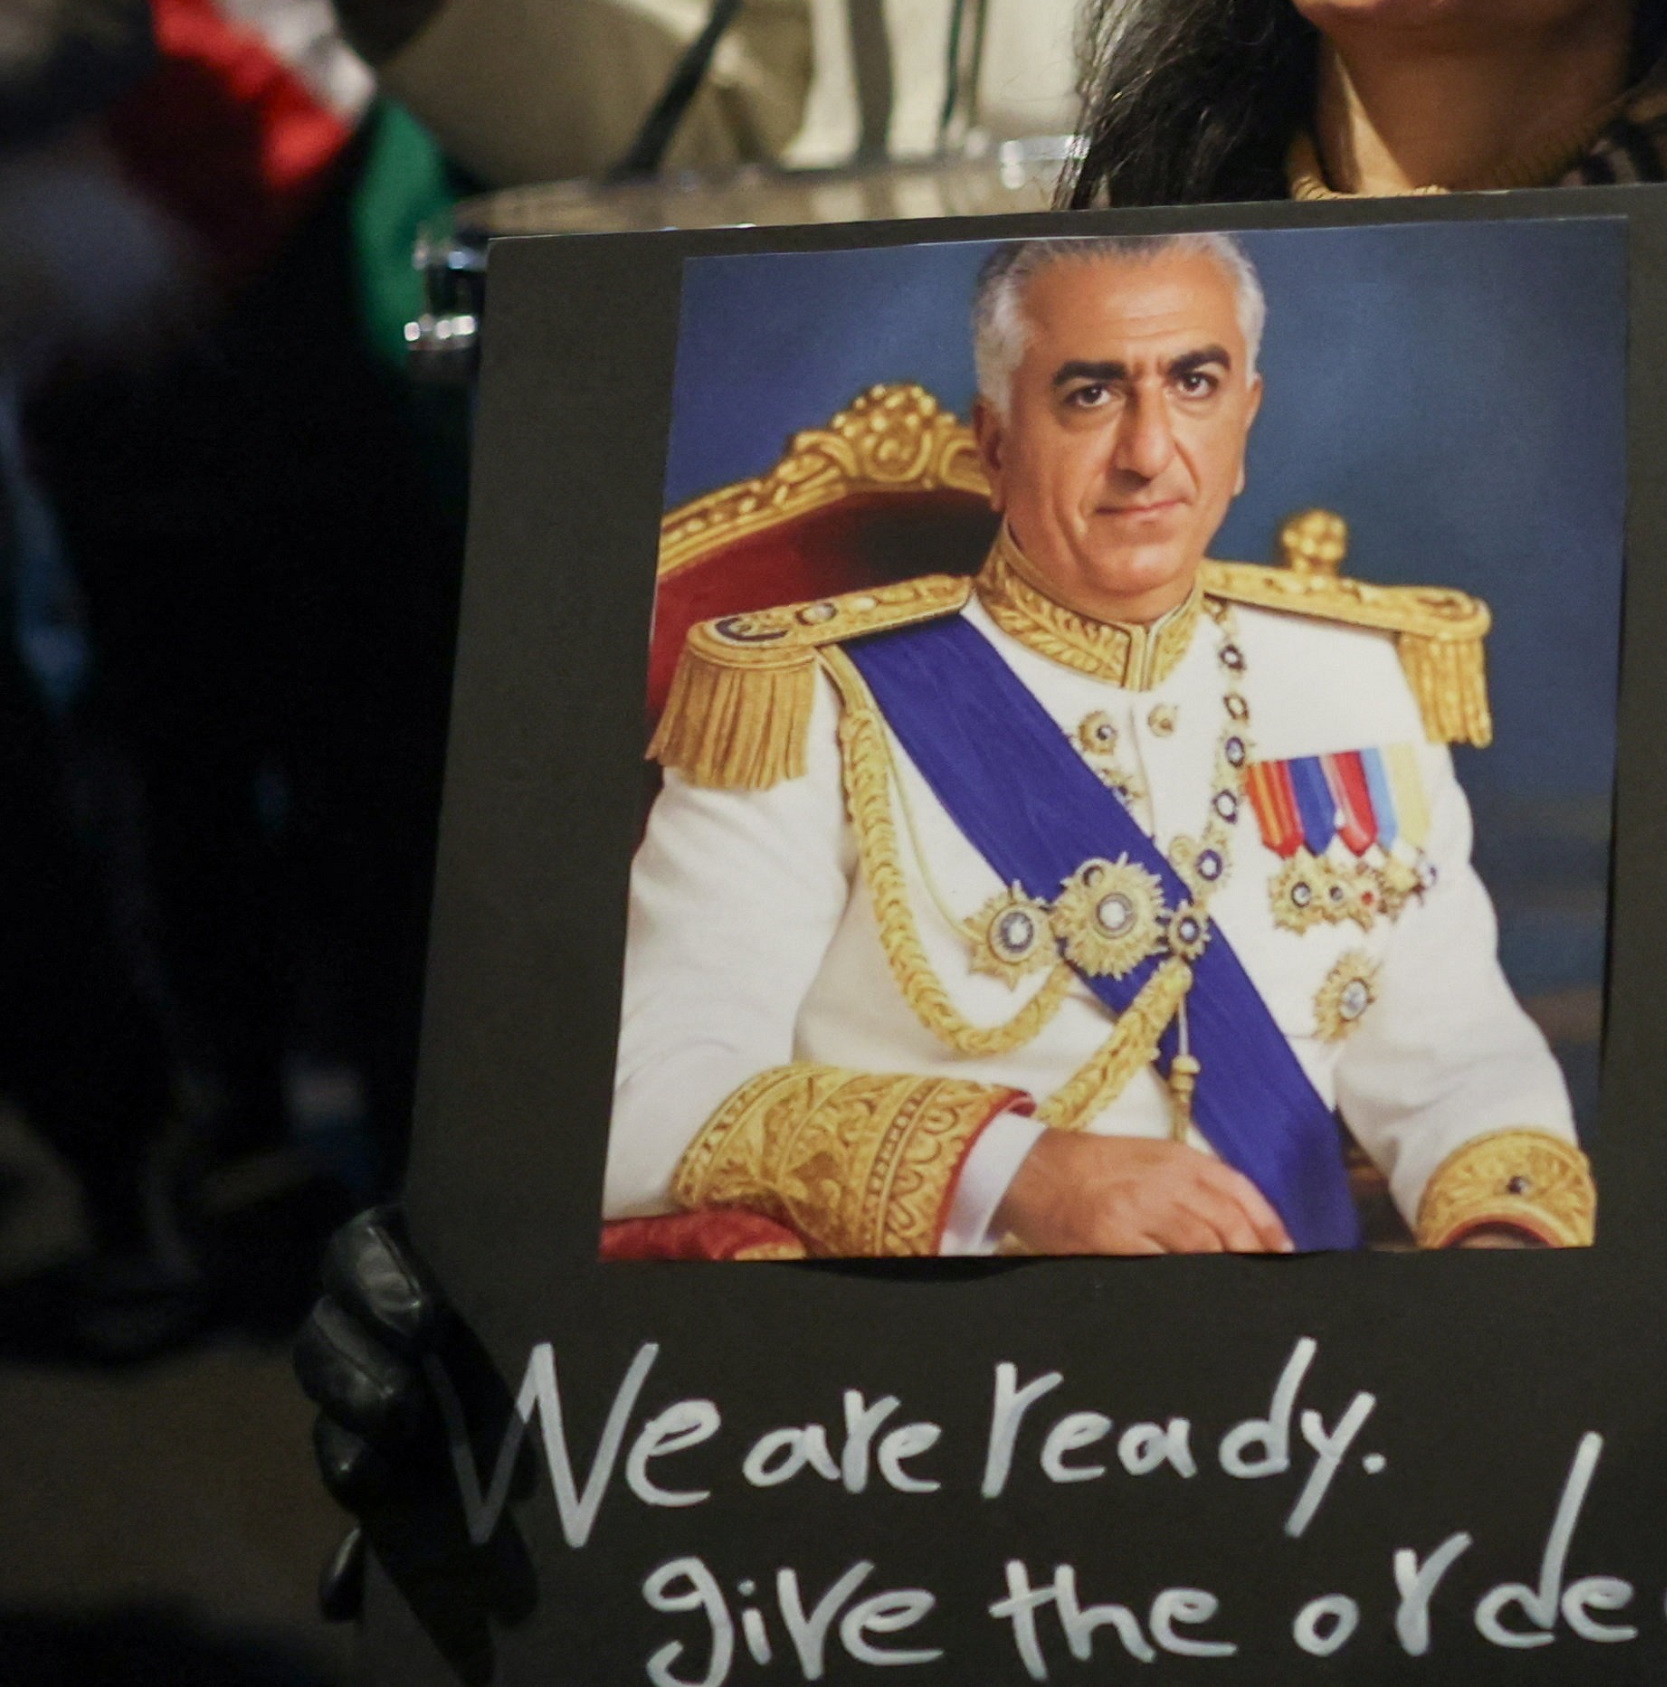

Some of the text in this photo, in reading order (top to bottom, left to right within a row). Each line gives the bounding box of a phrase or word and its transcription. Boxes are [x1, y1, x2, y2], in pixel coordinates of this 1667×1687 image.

[422, 1335, 1387, 1548] We are ready.
[642, 1555, 945, 1687] give
[987, 1558, 1238, 1681] the
